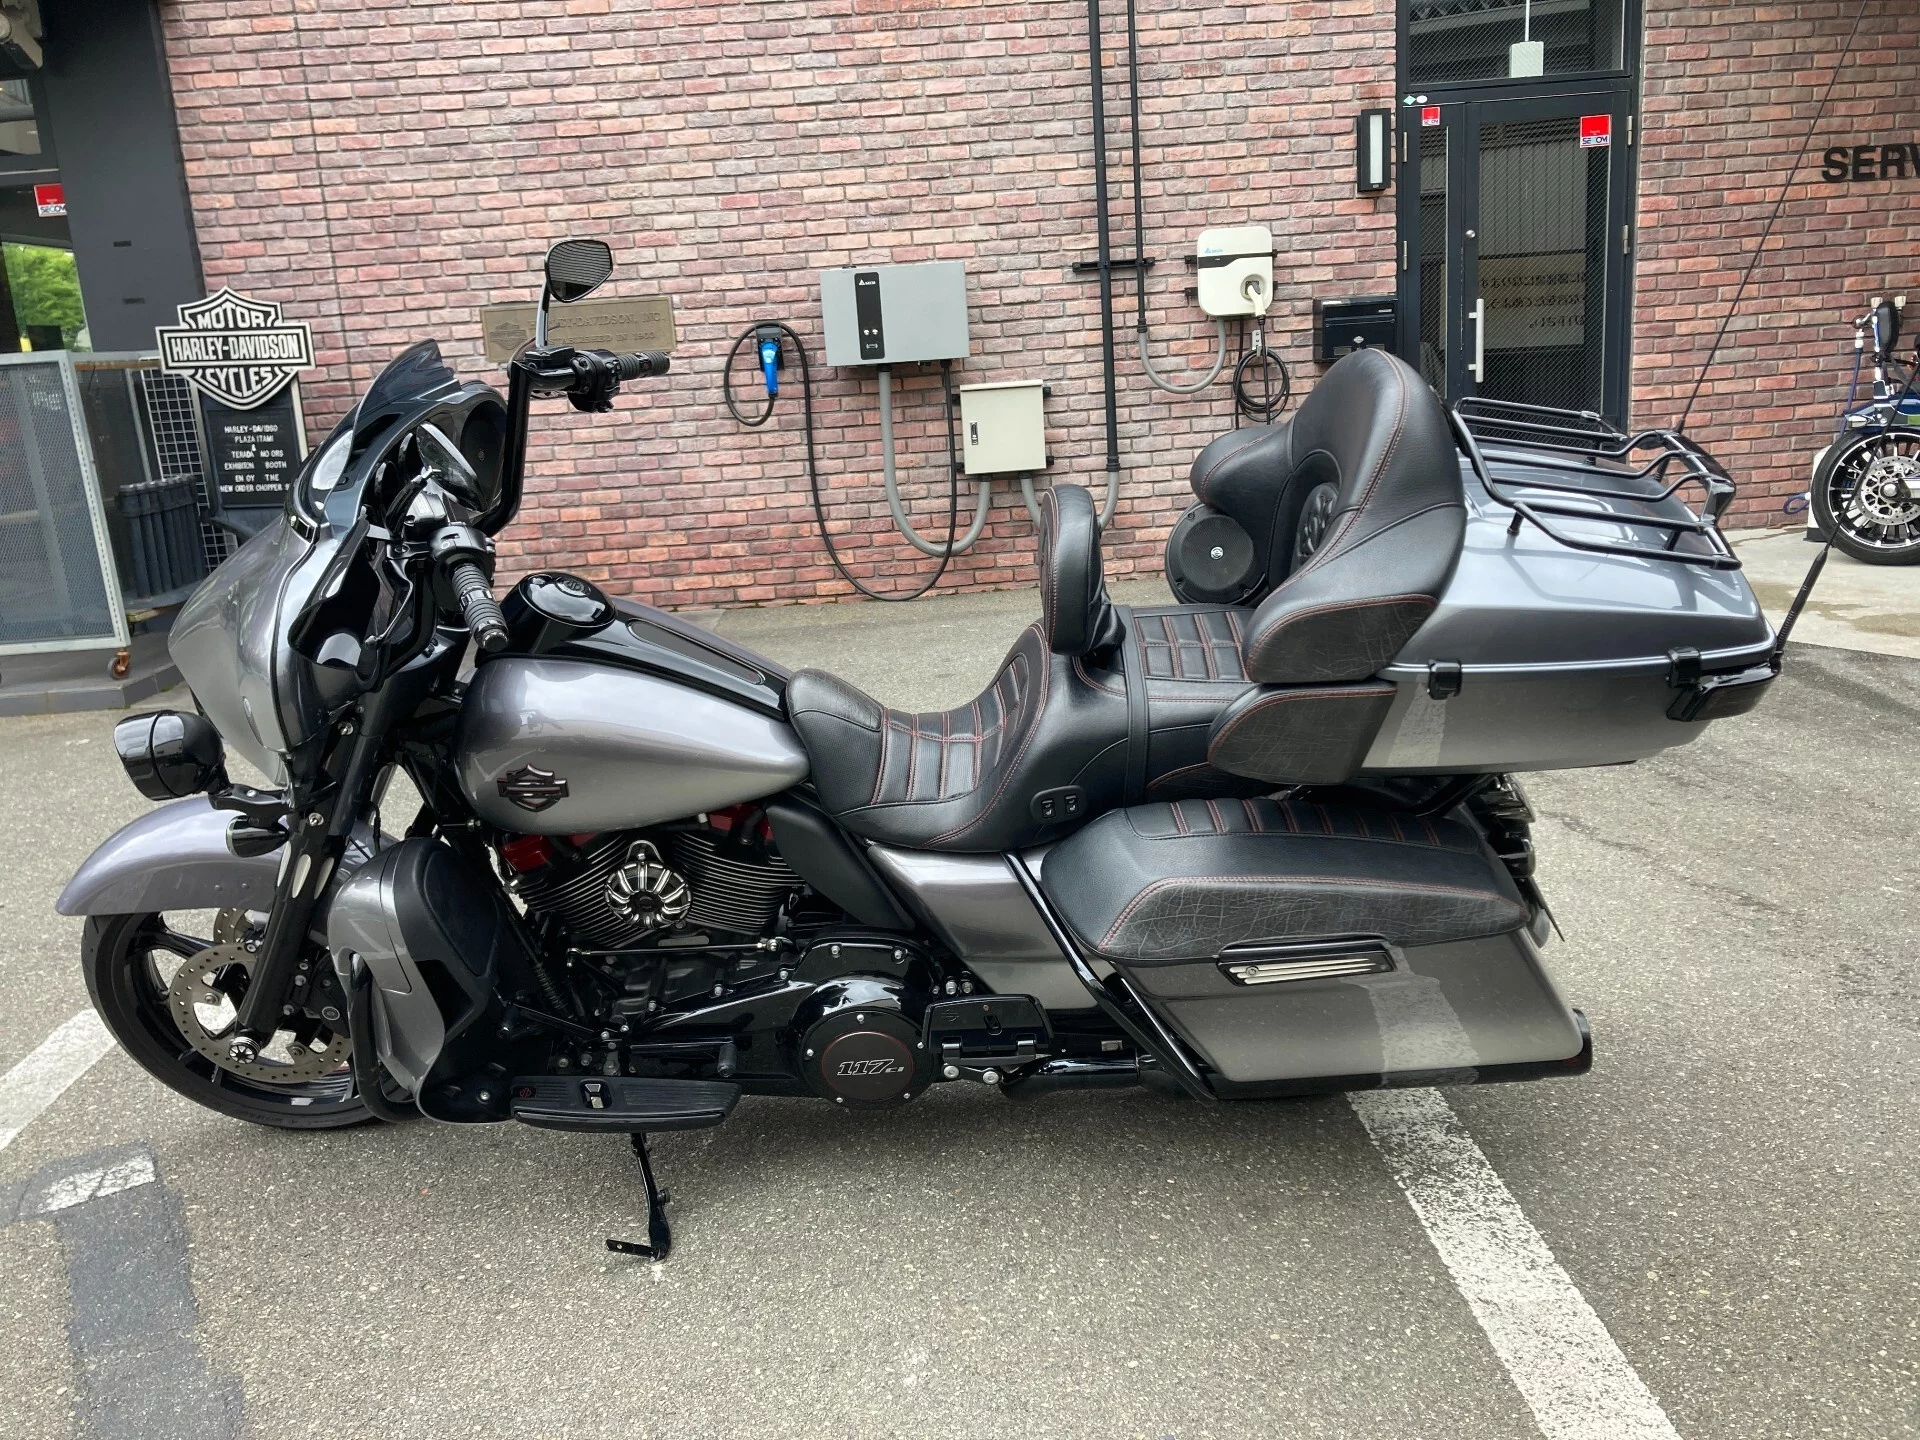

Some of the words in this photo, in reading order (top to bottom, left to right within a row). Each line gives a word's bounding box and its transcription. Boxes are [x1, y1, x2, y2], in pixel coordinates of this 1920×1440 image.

[197, 301, 266, 329] MOTOR
[171, 334, 300, 361] HARLEY-DAVIDSON
[205, 366, 273, 398] CYCLES
[234, 435, 255, 443] PLAZA
[265, 461, 287, 469] BOOTH
[220, 485, 233, 493] NEW
[235, 484, 254, 492] ORDER
[256, 483, 282, 492] CHOPPER
